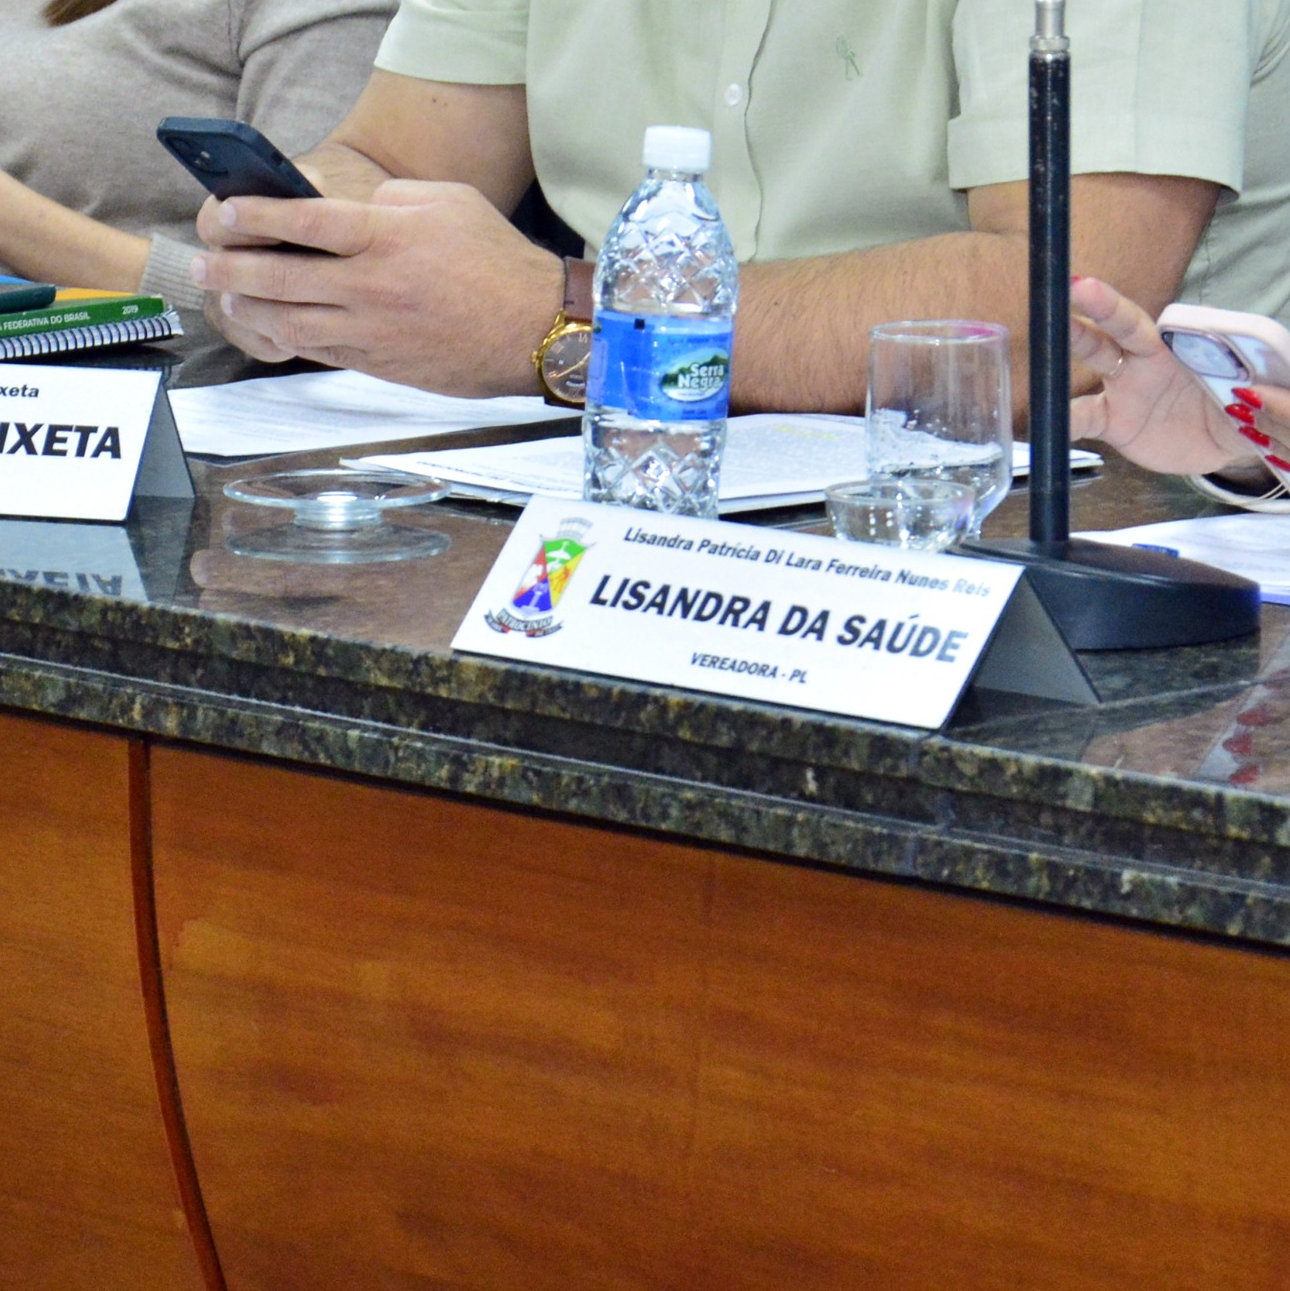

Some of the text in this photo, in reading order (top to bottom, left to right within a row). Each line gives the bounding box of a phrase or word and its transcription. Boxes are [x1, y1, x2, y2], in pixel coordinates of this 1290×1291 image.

[3, 316, 49, 331] FEDERATIVA
[51, 315, 63, 325] DO
[64, 311, 90, 322] BRASIL
[122, 305, 139, 315] 2019
[678, 374, 722, 392] Negra
[690, 363, 725, 377] Serra
[623, 527, 694, 550] Lisandra
[764, 548, 784, 564] Di
[785, 553, 823, 571] Lara
[825, 559, 892, 582] Ferreira
[894, 570, 949, 591] Nunes
[952, 578, 991, 598] Reis
[589, 574, 969, 663] LISANDRA DA SAÚDE
[690, 652, 778, 679] VEREADORA
[789, 668, 807, 684] PL
